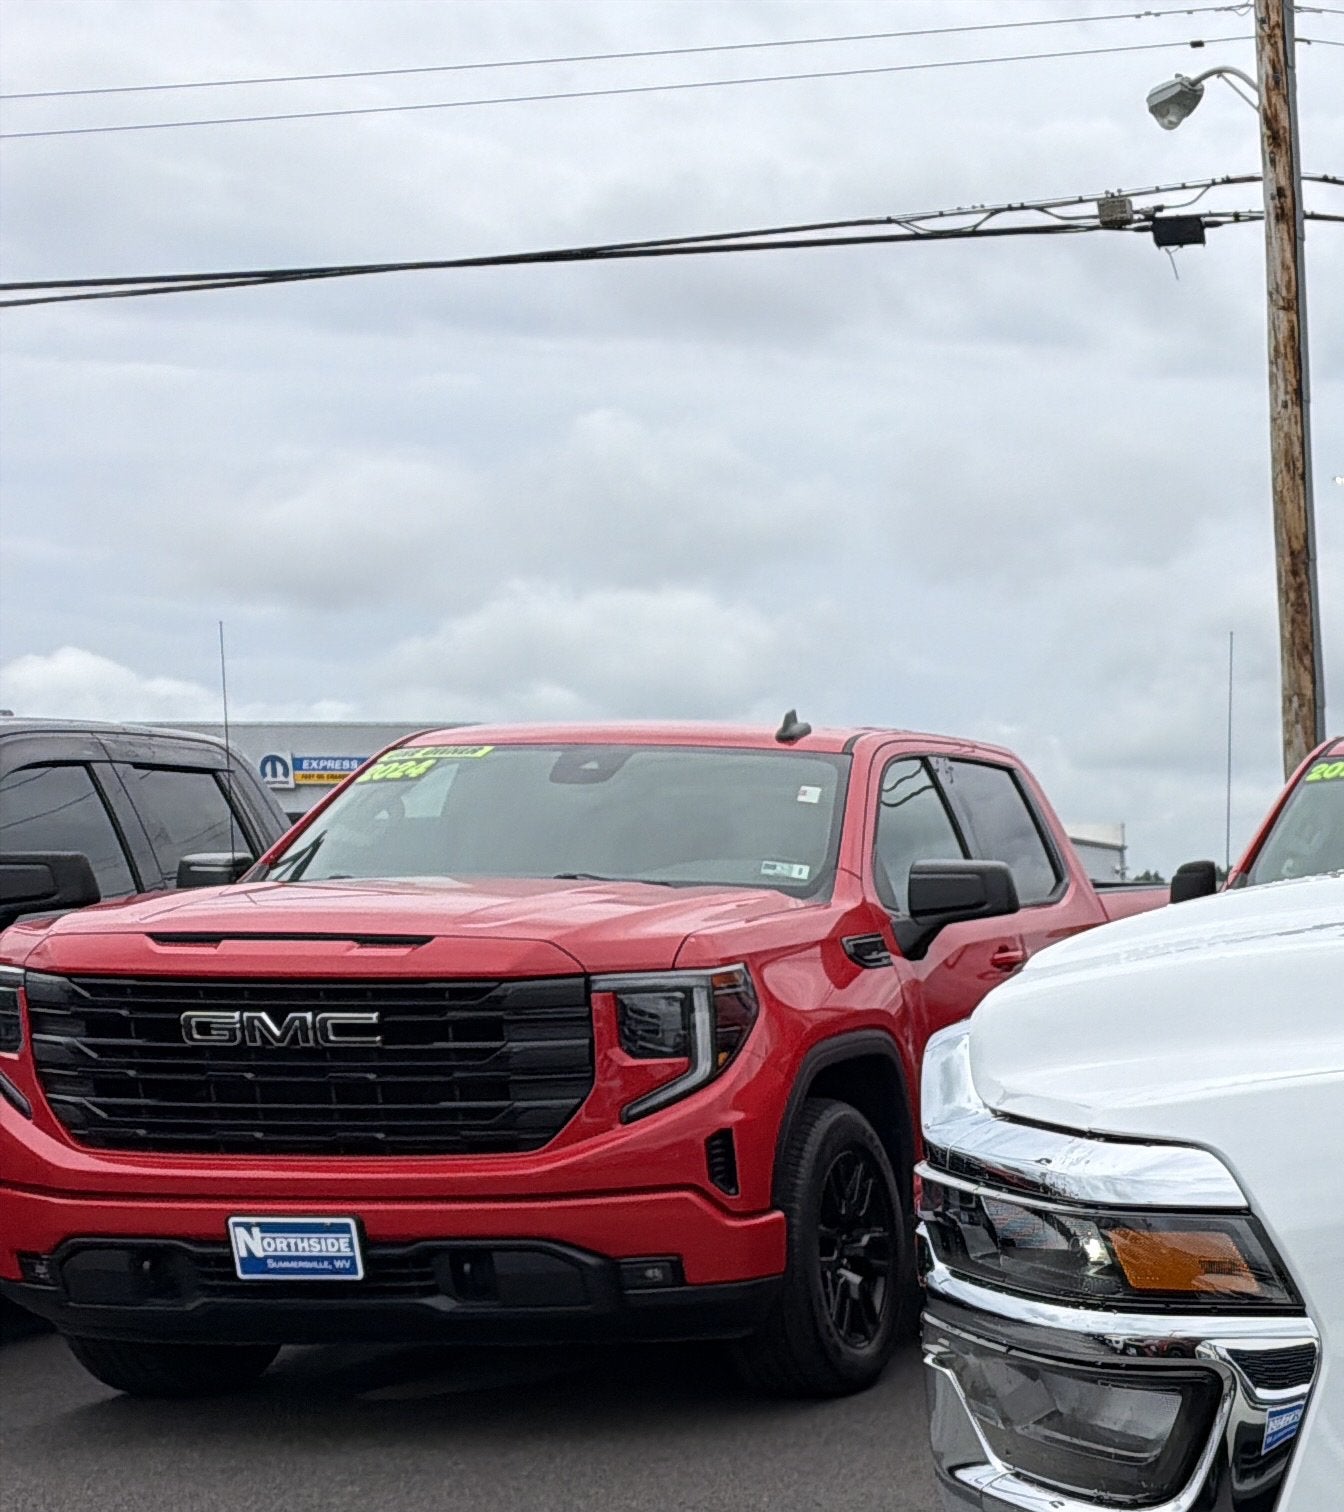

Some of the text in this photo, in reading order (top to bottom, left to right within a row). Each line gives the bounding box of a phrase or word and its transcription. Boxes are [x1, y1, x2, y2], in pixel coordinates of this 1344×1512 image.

[302, 759, 358, 770] EXPRESS
[180, 1011, 382, 1047] GMC
[234, 1226, 352, 1258] NORTHSIDE
